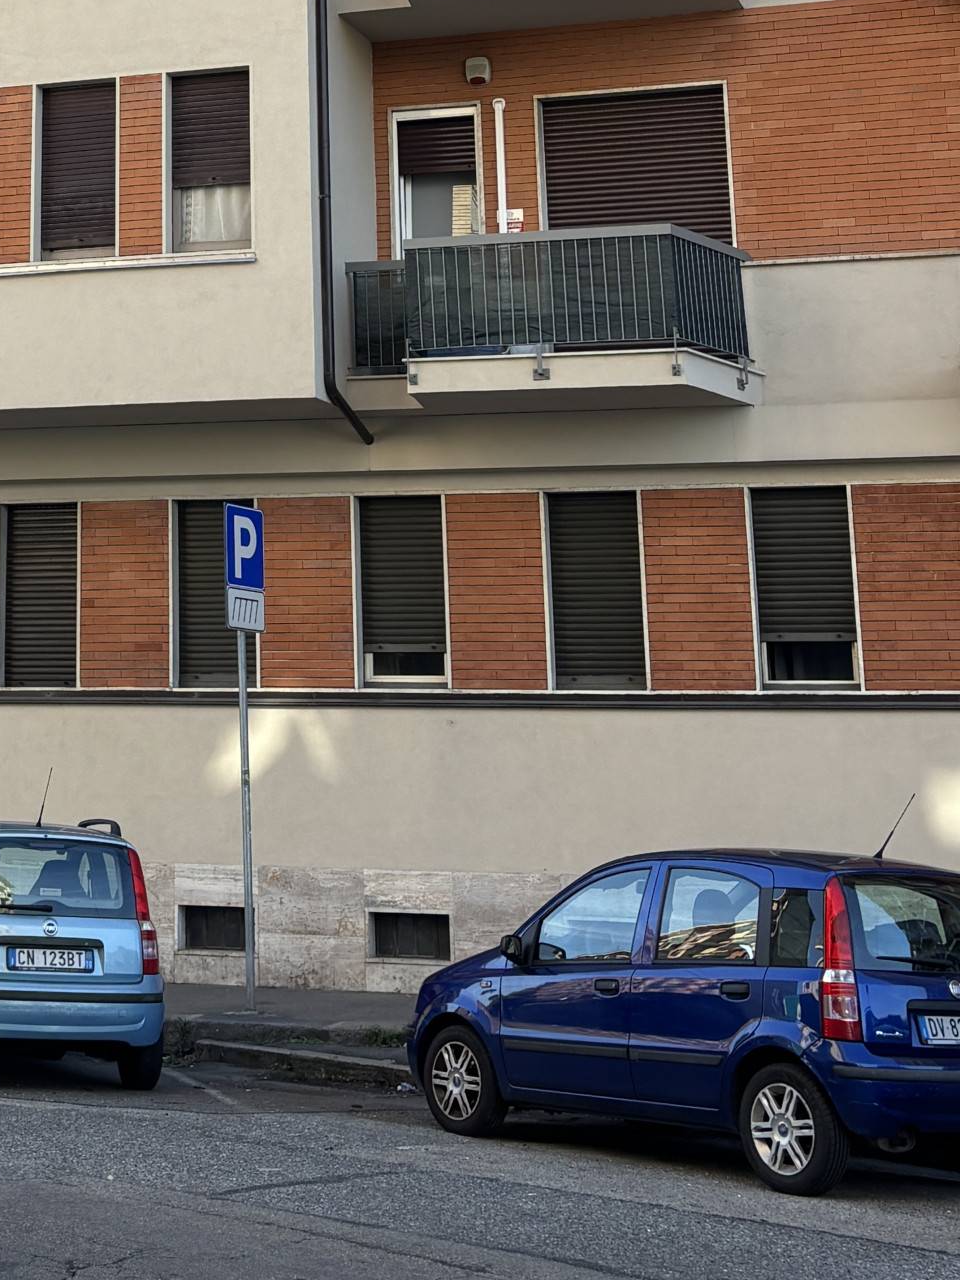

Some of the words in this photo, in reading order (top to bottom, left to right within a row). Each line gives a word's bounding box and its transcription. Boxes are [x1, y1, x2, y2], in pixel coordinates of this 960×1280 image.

[234, 515, 257, 579] P
[17, 950, 35, 965] CN
[42, 951, 83, 967] 123BT
[928, 1017, 945, 1037] DV
